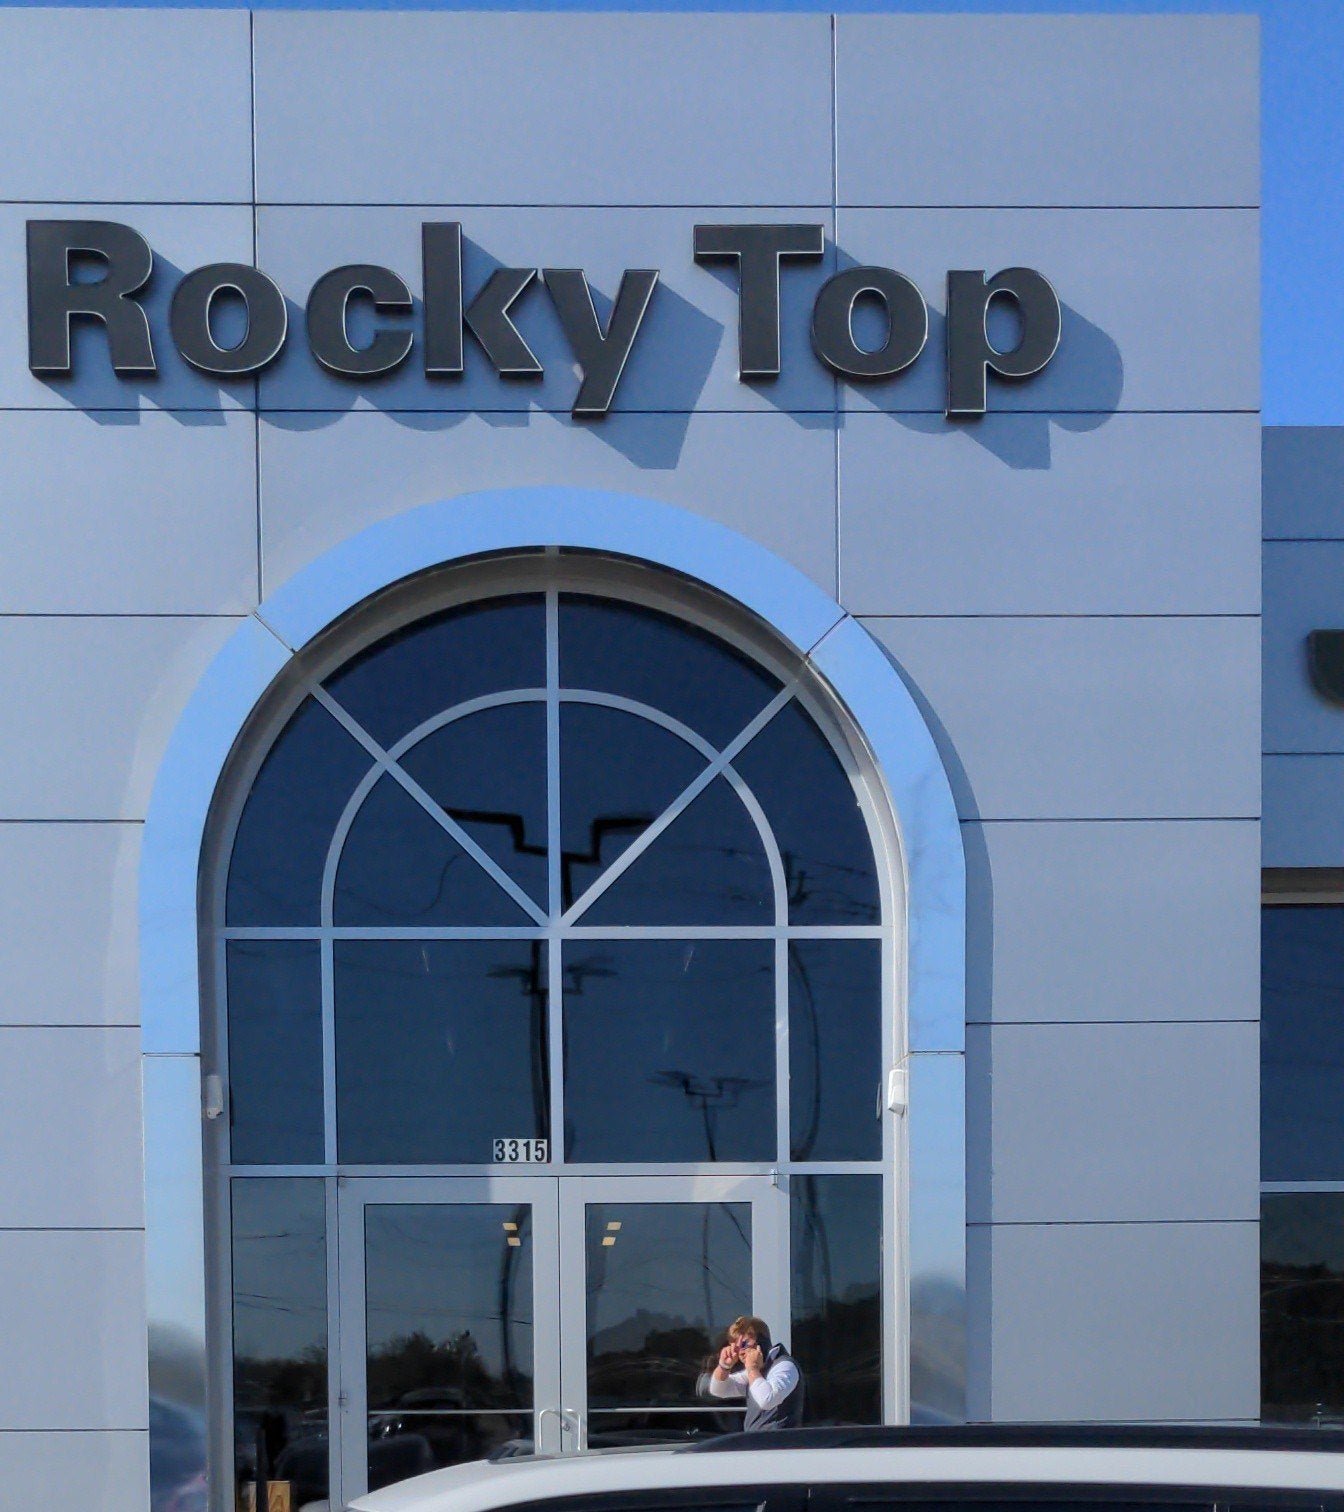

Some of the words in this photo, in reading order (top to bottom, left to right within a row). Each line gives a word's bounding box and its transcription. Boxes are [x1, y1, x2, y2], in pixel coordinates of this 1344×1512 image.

[26, 220, 659, 418] Rocky
[692, 223, 1061, 419] Top
[494, 1139, 545, 1162] 3315
